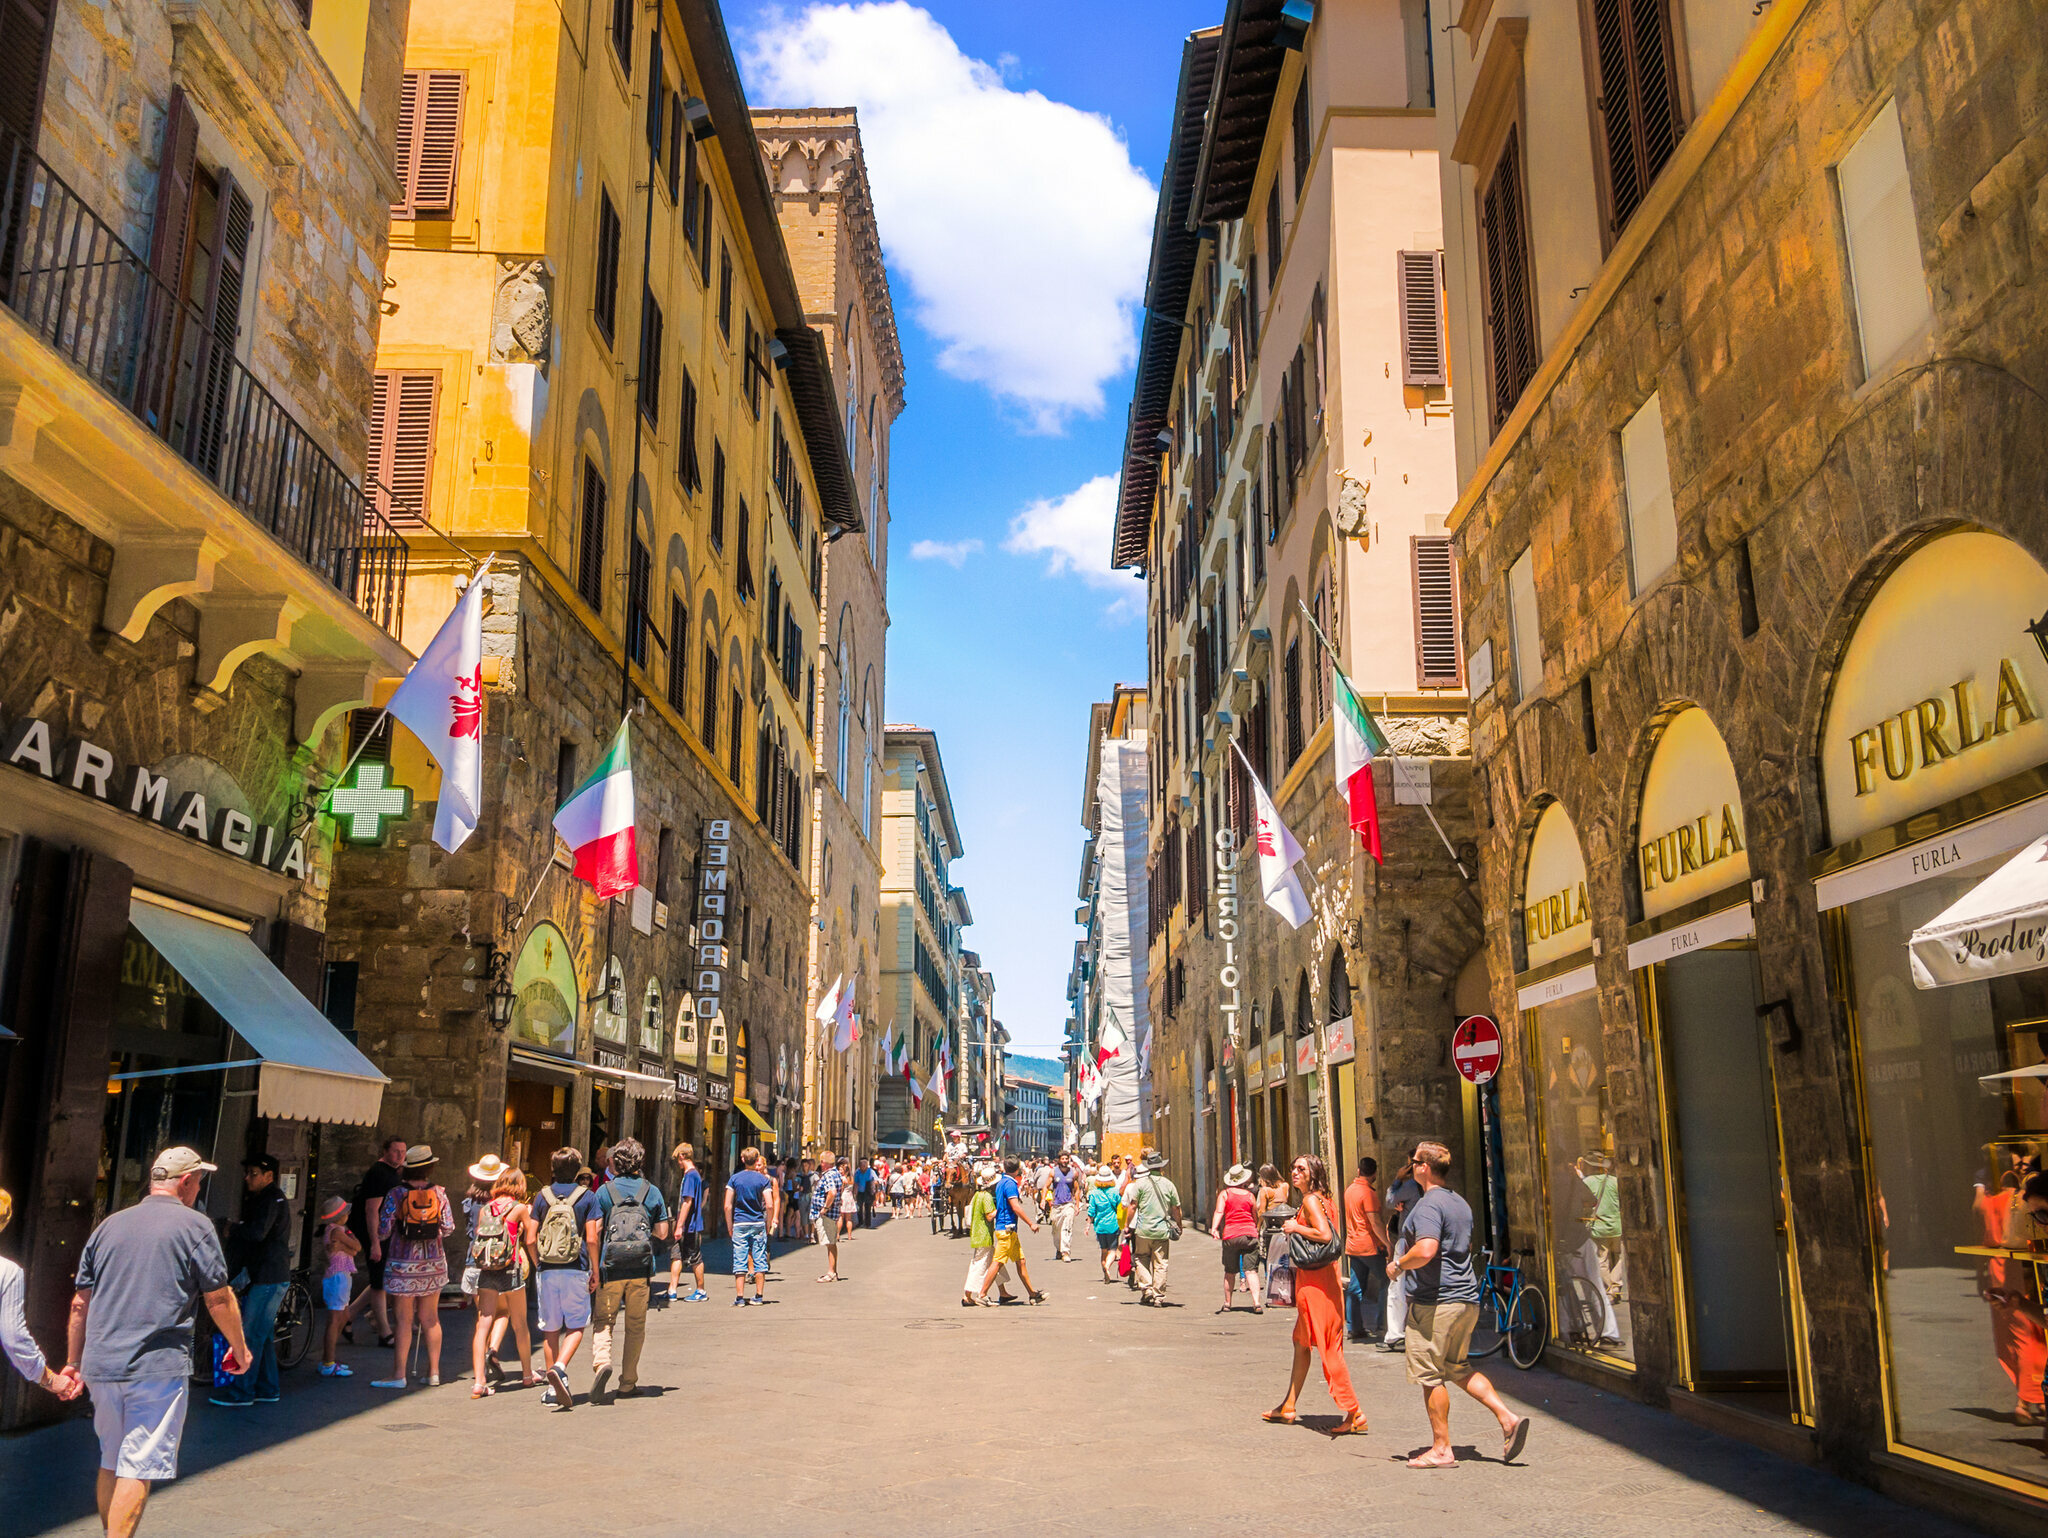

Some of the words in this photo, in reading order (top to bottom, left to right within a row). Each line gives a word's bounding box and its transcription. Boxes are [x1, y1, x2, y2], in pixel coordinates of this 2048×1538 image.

[1850, 658, 2037, 798] FURLA
[5, 718, 306, 880] ARMACIA
[1642, 803, 1744, 892] FURLA
[1911, 843, 1962, 875] FURLA
[1525, 881, 1589, 946] FURLA
[1671, 931, 1699, 952] FURLA
[1956, 919, 2048, 964] Produz
